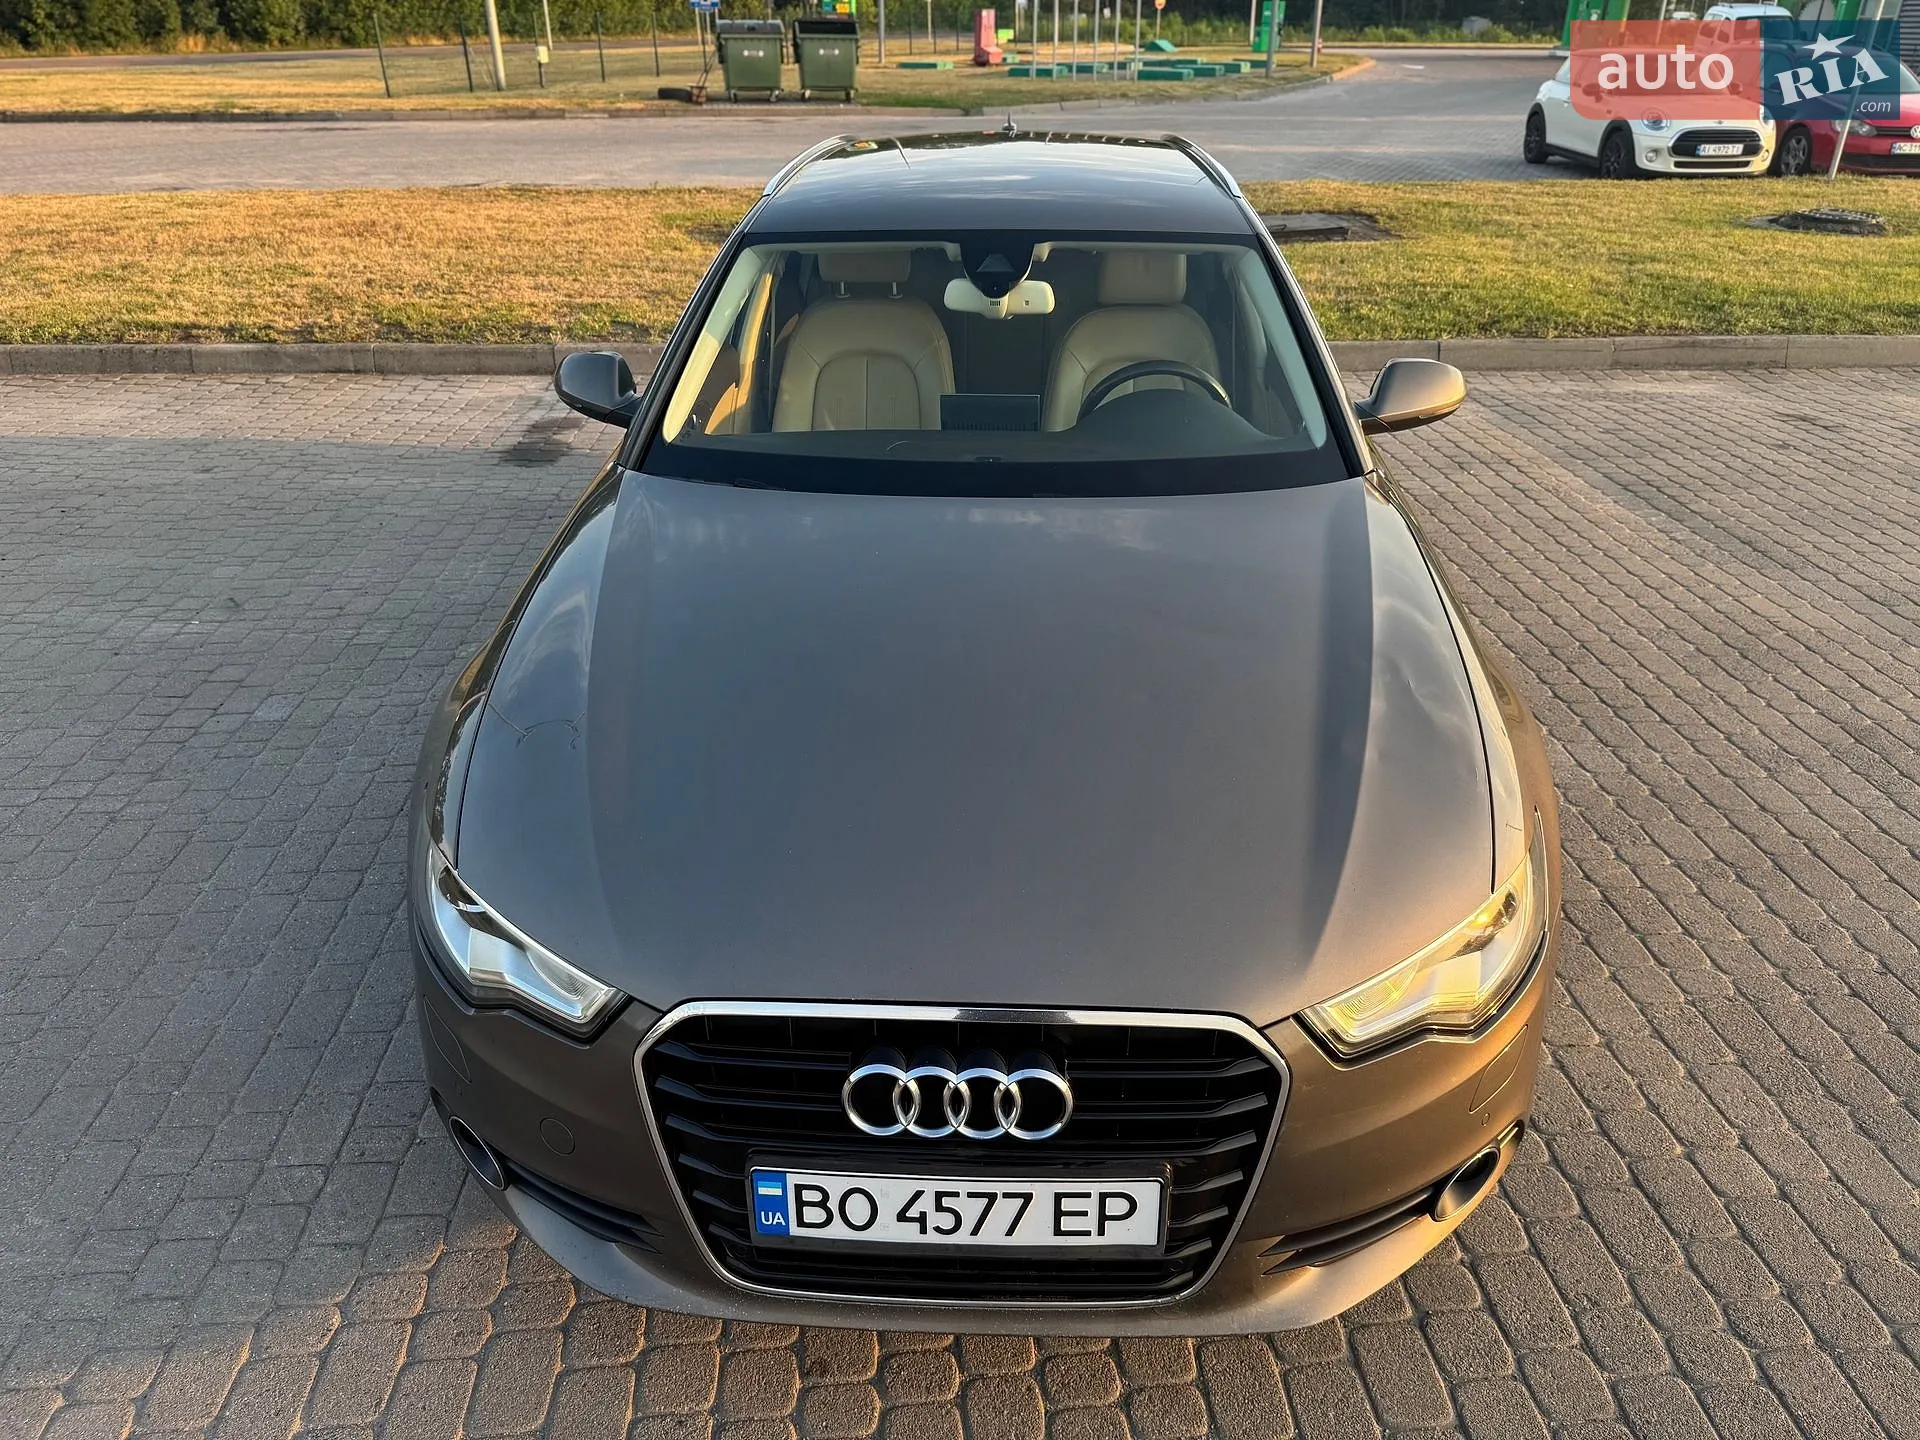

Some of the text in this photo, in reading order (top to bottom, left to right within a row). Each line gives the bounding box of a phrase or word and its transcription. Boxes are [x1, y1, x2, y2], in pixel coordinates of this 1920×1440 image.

[761, 1211, 786, 1226] UA
[794, 1183, 1138, 1237] BO 4577 EP
